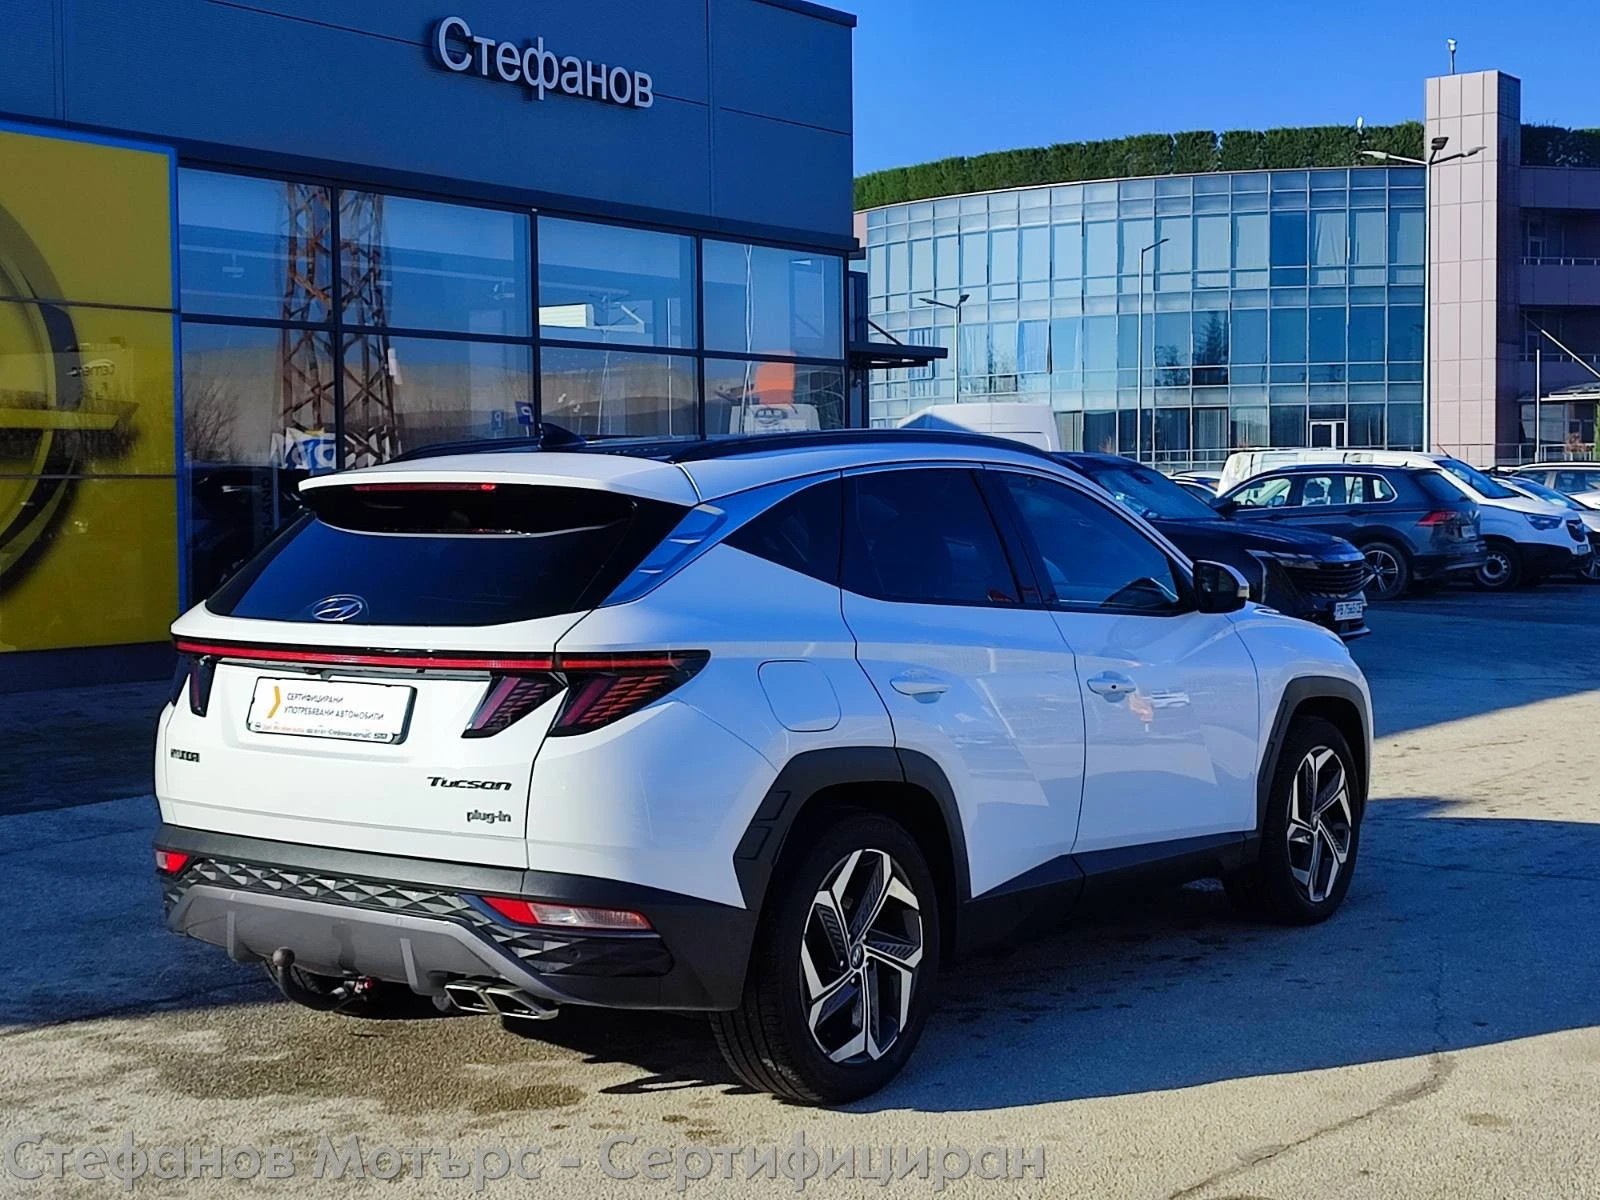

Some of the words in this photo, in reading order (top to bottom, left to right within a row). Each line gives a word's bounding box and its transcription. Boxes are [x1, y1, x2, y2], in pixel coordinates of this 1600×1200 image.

[437, 16, 654, 109] Стефанов
[287, 693, 343, 703] СЕРТИФИЦИРАНИ
[284, 706, 334, 716] УПОТРЕБЯВАНИ
[335, 710, 384, 720] АВТОМОБИЛИ
[427, 776, 512, 791] Tucson
[466, 809, 512, 824] plug-in
